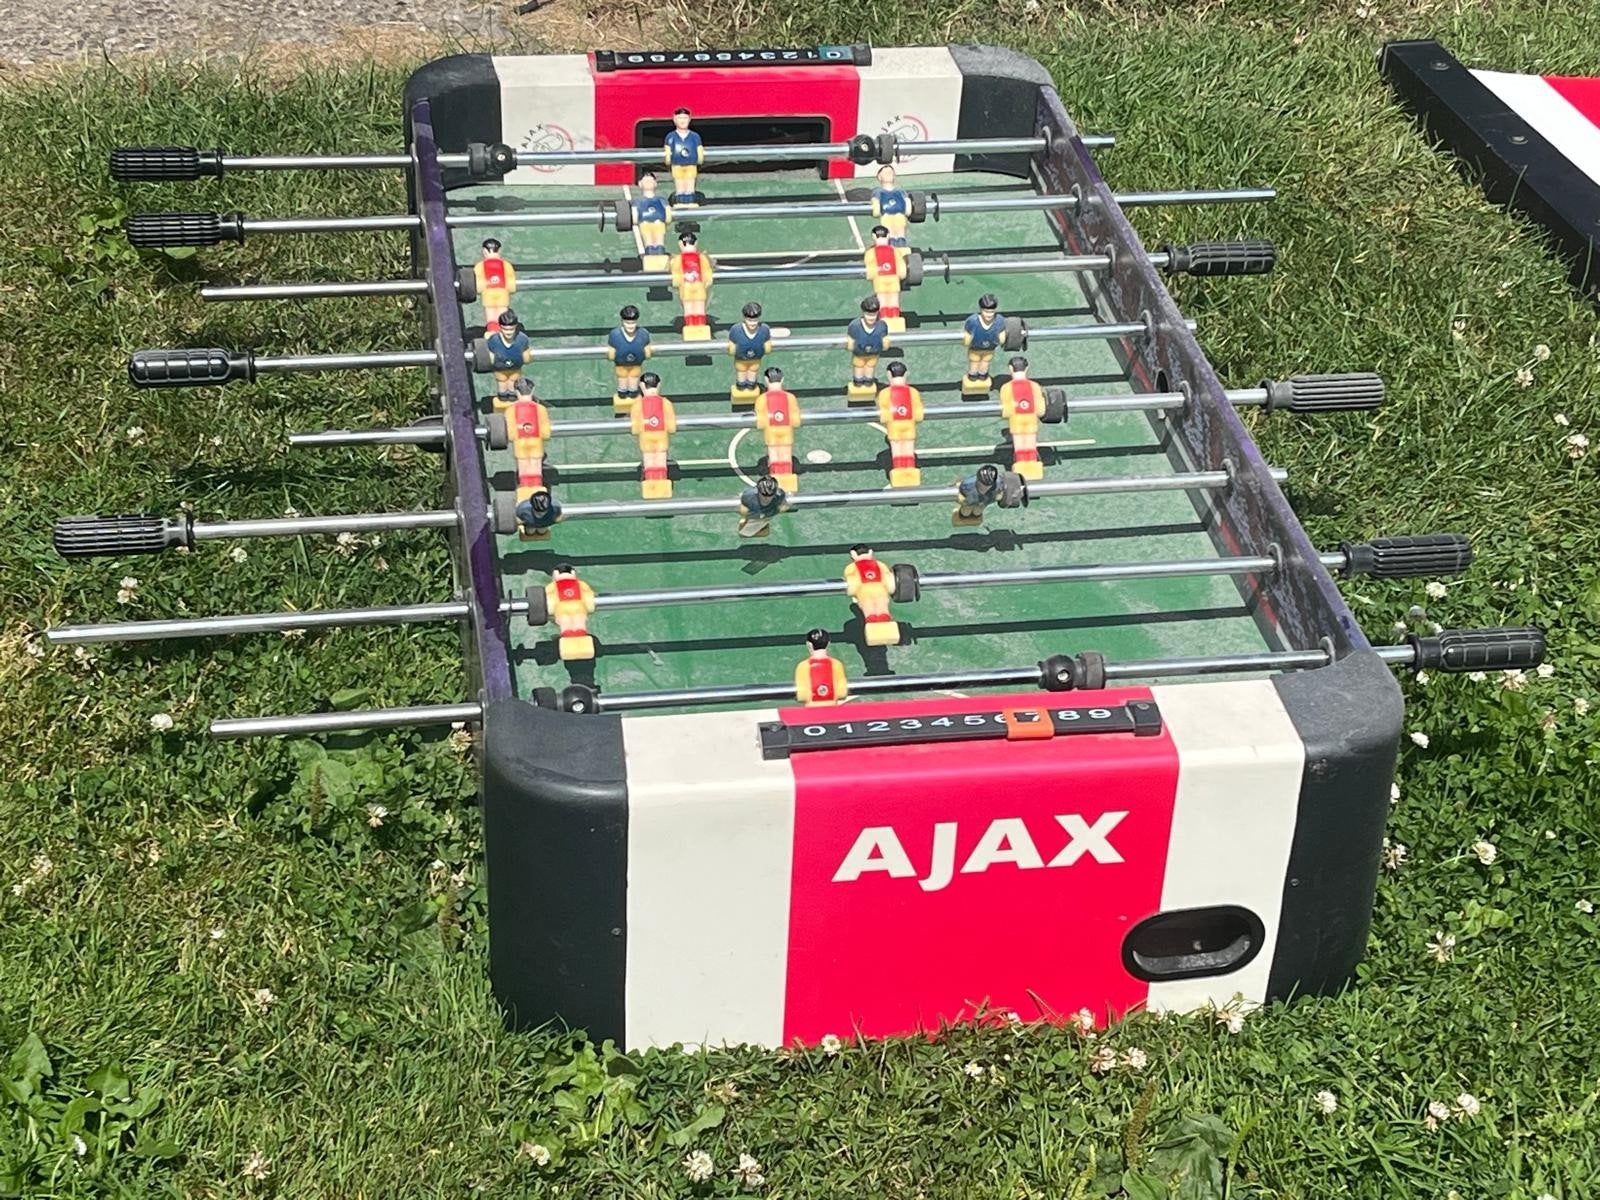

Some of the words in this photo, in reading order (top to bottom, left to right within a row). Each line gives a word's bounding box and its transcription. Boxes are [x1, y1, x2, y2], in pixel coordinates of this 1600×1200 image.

[521, 123, 544, 149] AJAX
[803, 725, 827, 736] 0
[867, 721, 891, 732] 2
[899, 719, 922, 729] 3
[930, 717, 954, 727] 4
[964, 715, 986, 725] 5
[1057, 710, 1081, 721] 8
[1088, 708, 1112, 719] 9
[831, 810, 1130, 892] AJAX
